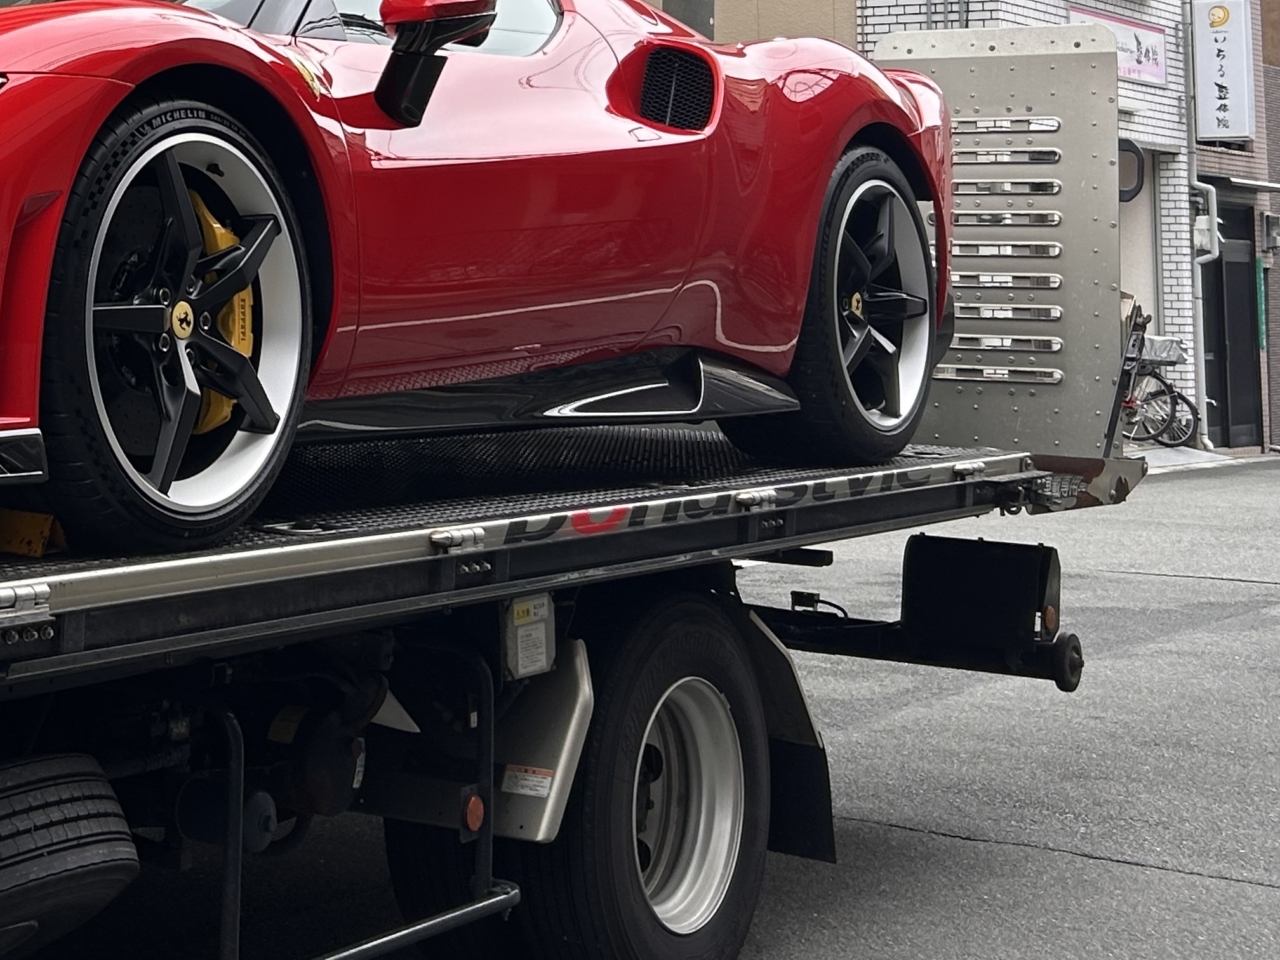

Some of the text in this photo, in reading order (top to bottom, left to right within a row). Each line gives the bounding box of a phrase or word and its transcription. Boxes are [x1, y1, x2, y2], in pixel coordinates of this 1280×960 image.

[1213, 36, 1230, 129] いちる整体院
[151, 109, 206, 128] MICHELIN
